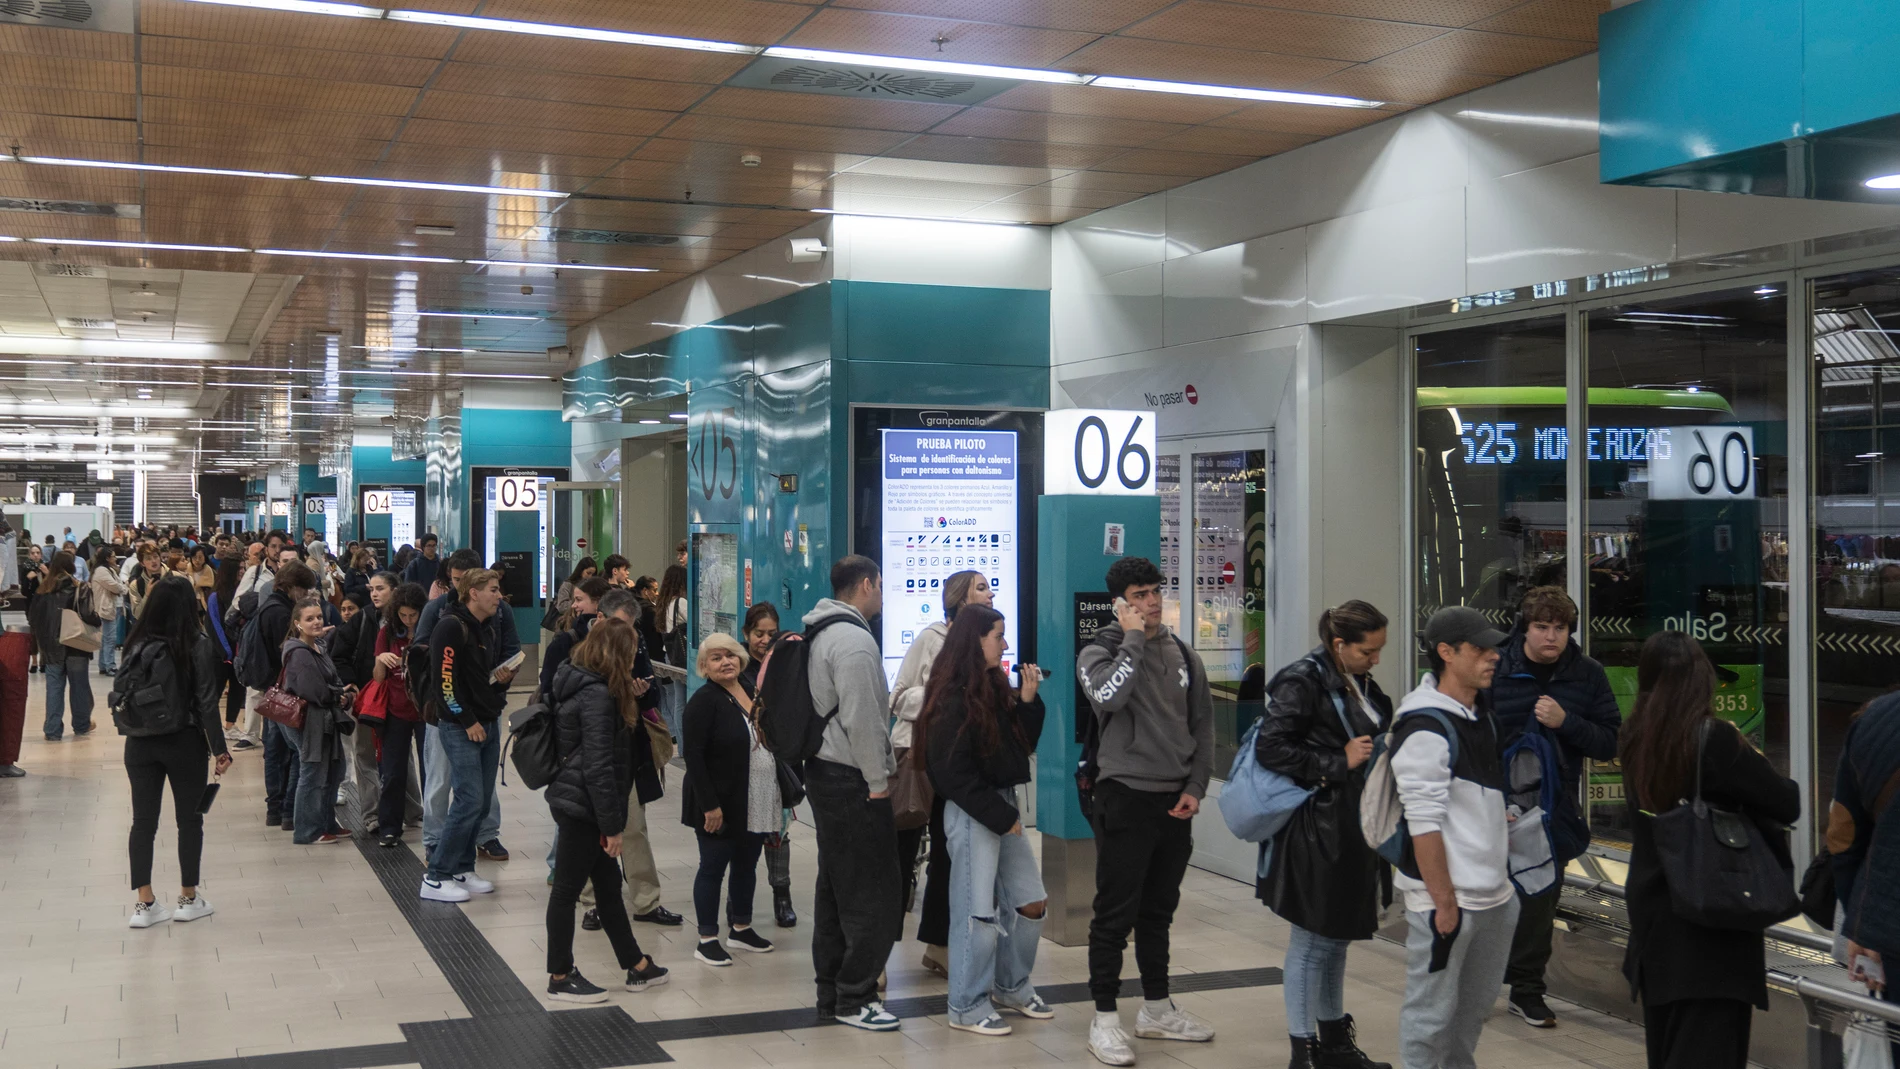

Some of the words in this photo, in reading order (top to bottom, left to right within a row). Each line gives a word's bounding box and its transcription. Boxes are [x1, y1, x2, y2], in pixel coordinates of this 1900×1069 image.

[1144, 392, 1158, 407] No
[1160, 391, 1184, 408] pasar
[926, 416, 986, 428] granpantalla
[916, 438, 952, 449] PRUEBA
[954, 438, 986, 450] PILOTO
[1534, 427, 1601, 460] MONE
[1605, 428, 1672, 460] ROZAS
[701, 407, 737, 501] 05
[889, 453, 917, 463] Sistema
[920, 454, 930, 463] de
[931, 454, 976, 464] identificación
[977, 455, 986, 464] de
[987, 456, 1012, 464] colores
[1074, 415, 1151, 490] 06
[901, 466, 917, 476] para
[919, 466, 950, 476] personas
[952, 467, 964, 475] con
[965, 465, 1002, 475] daltonismo
[501, 478, 536, 507] 05
[274, 503, 287, 514] 02
[308, 500, 324, 513] 03
[368, 493, 390, 512] 04
[1080, 618, 1098, 628] 623
[441, 646, 463, 715] CALIFORNIA
[1715, 694, 1748, 712] 353
